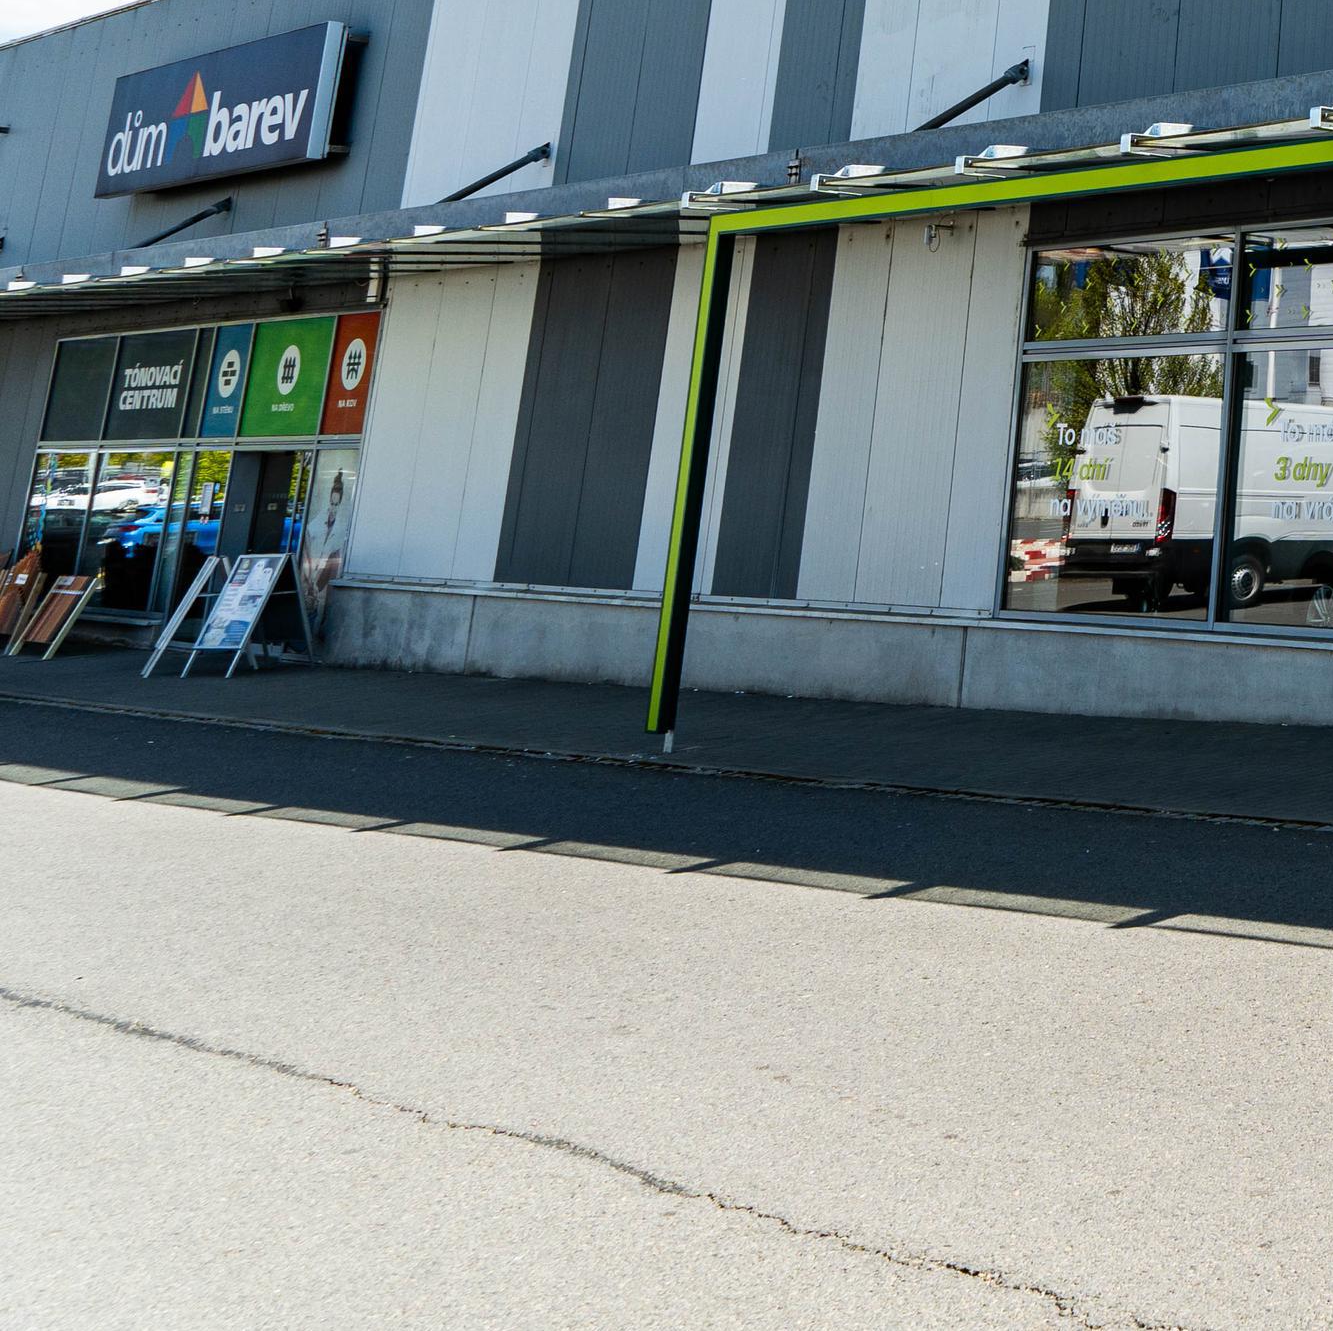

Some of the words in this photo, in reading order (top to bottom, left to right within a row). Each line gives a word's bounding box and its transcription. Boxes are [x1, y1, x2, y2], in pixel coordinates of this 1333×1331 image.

[107, 110, 168, 177] dům
[202, 88, 310, 158] barev
[123, 359, 184, 388] TÓNOVACÍ
[119, 387, 178, 411] CENTRUM
[1057, 423, 1076, 446] To
[1080, 423, 1118, 446] máš
[1280, 419, 1302, 442] To
[1052, 457, 1075, 481] 14
[1079, 457, 1112, 481] dní
[1274, 456, 1290, 481] 3
[1293, 456, 1333, 487] dny
[1050, 498, 1071, 516] na
[1272, 500, 1299, 521] na
